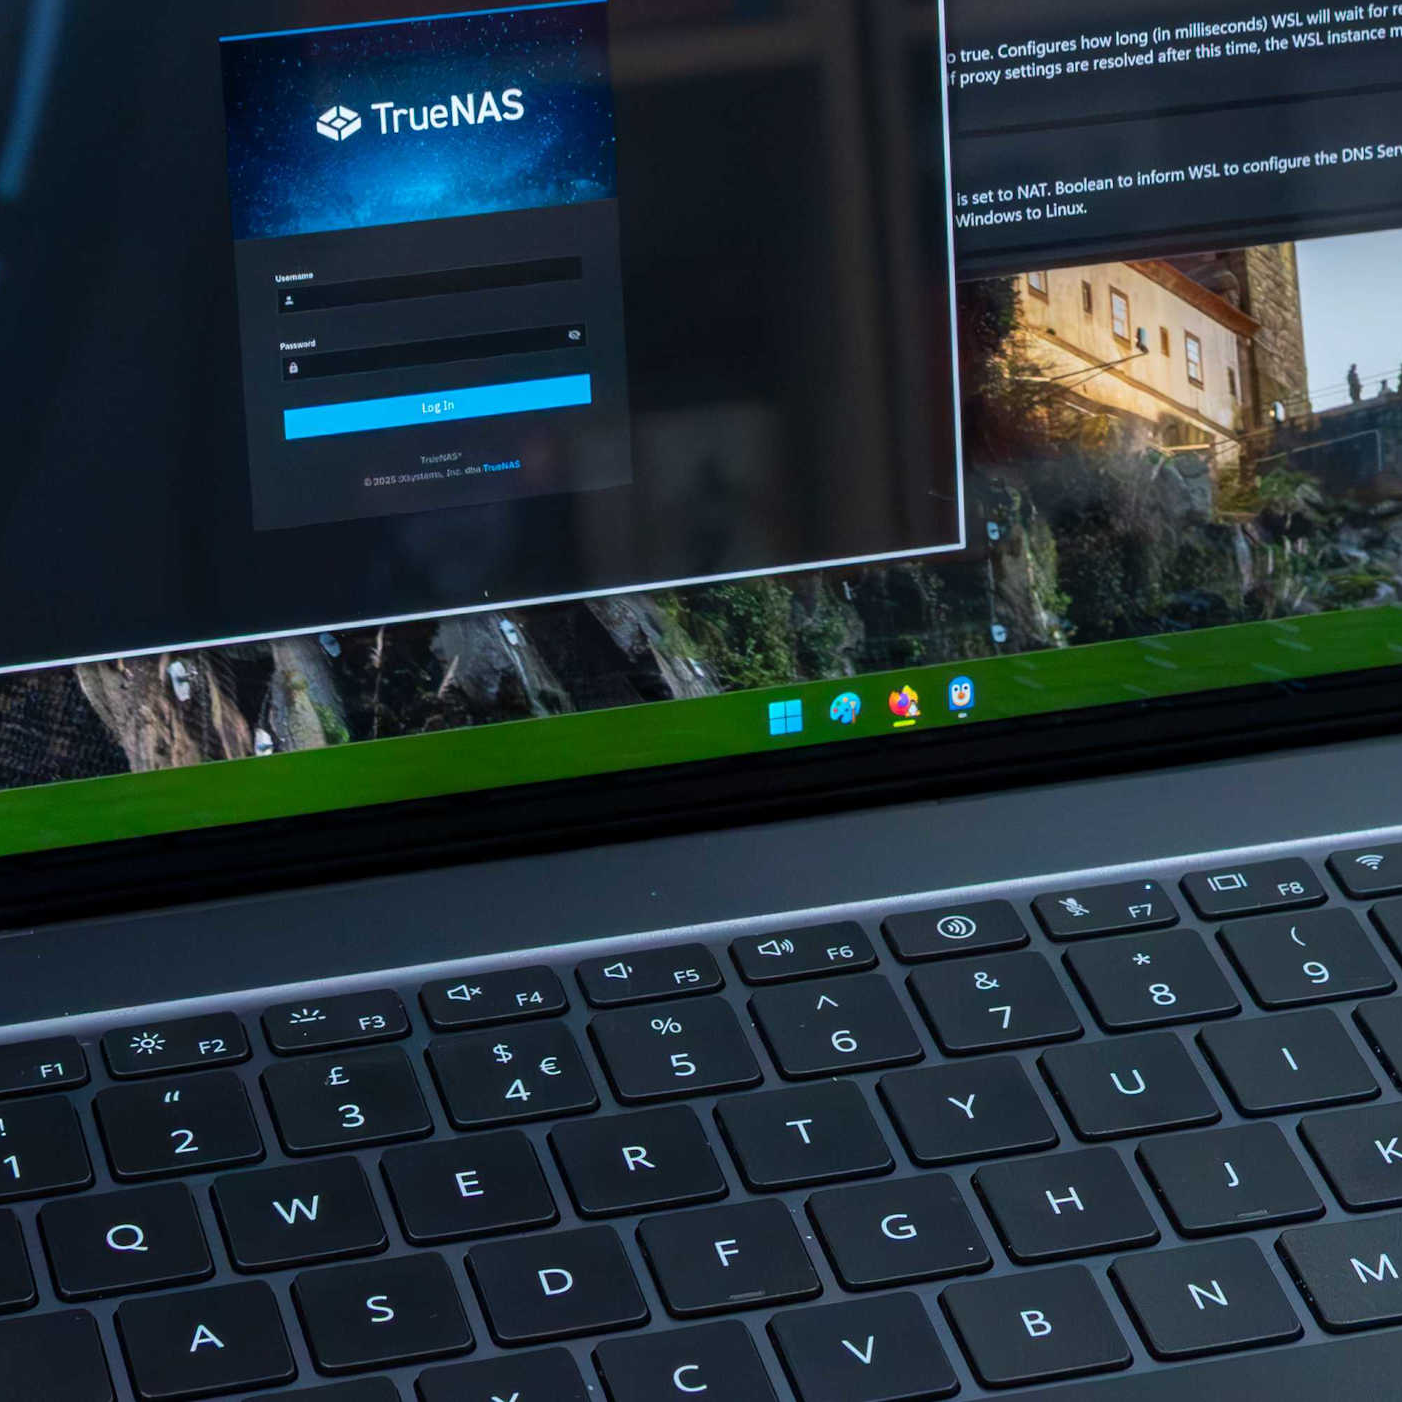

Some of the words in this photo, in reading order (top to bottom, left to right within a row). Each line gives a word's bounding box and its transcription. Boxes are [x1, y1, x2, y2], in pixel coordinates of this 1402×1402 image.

[370, 88, 525, 135] TrueNAS
[955, 209, 1022, 228] Windows
[1026, 207, 1042, 221] to
[1046, 202, 1087, 219] Linux.
[274, 272, 314, 283] Username
[279, 339, 317, 351] Password
[421, 402, 442, 414] Log
[443, 400, 455, 411] In
[456, 1171, 483, 1196] E
[273, 1195, 318, 1223] W
[107, 1225, 148, 1250] Q
